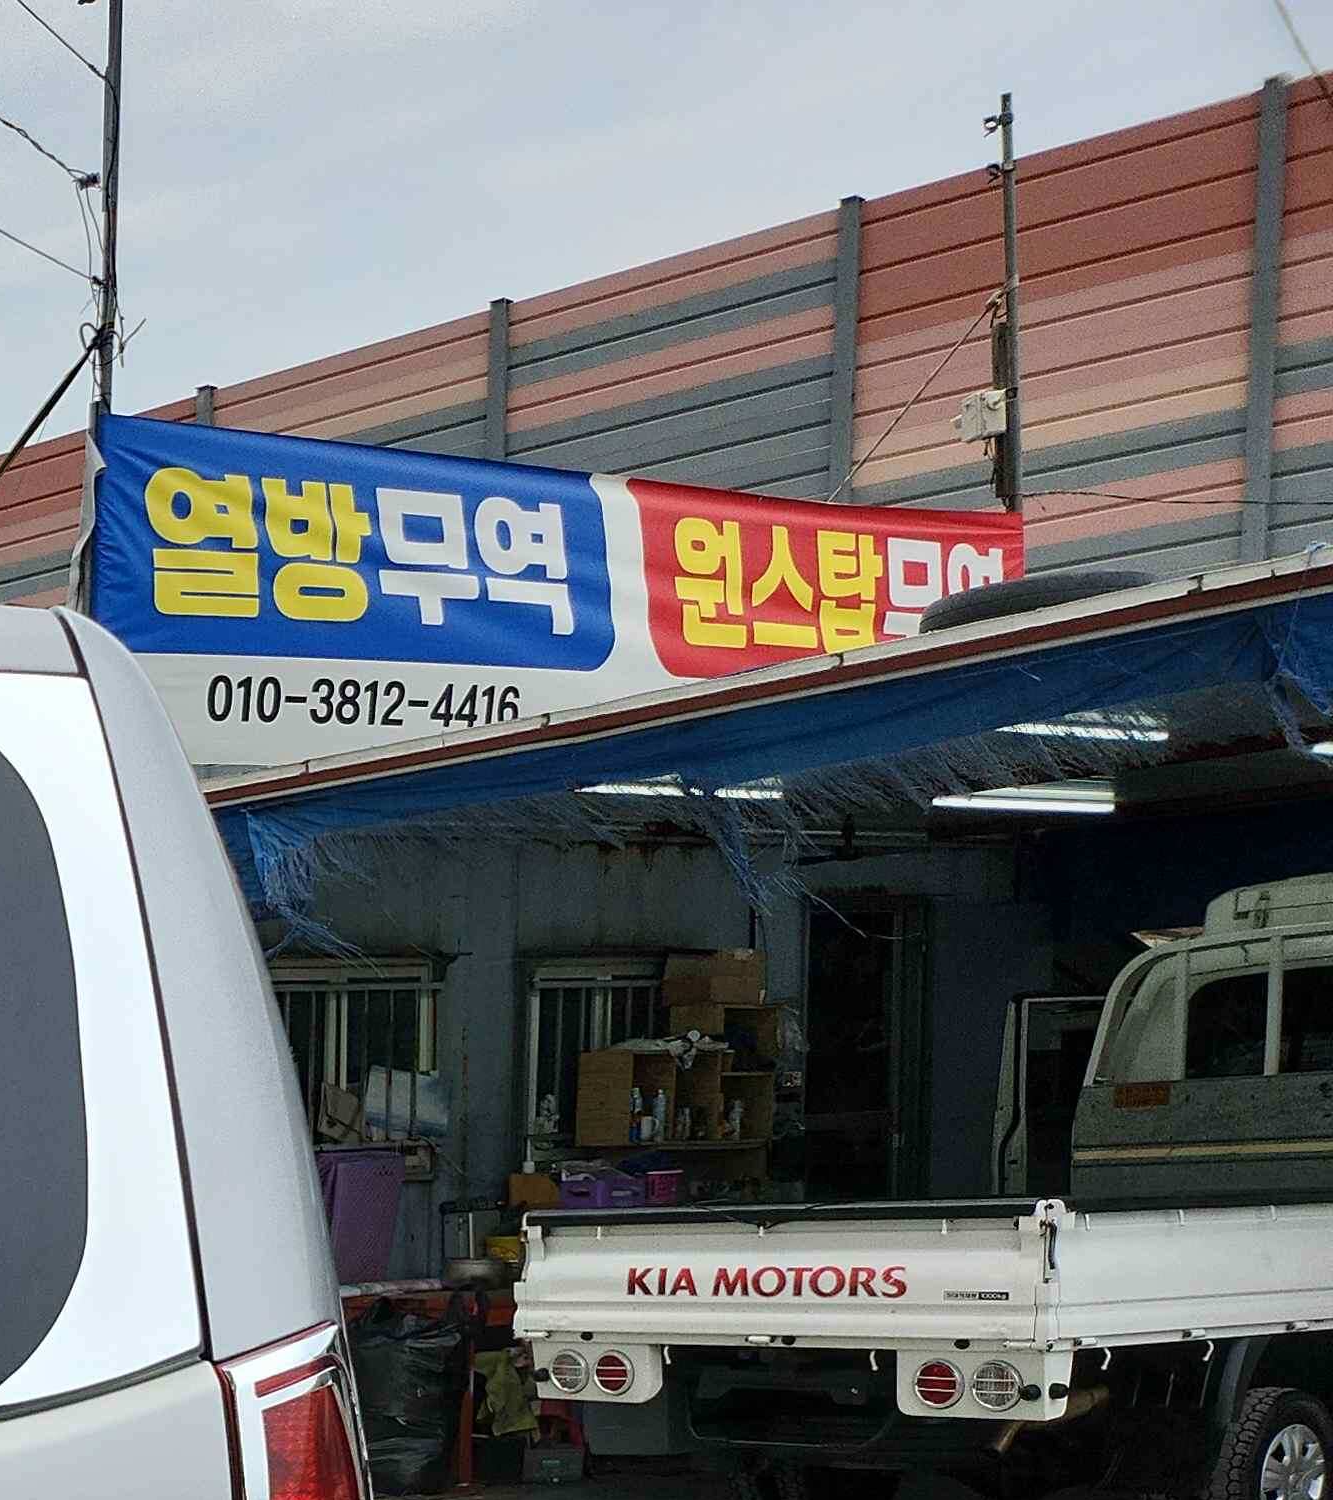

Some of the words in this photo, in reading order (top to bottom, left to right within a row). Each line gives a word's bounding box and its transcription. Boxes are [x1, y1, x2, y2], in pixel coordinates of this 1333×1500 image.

[144, 466, 574, 636] 열방무역
[207, 674, 520, 728] 010-3812-4416
[627, 1266, 699, 1298] KIA
[711, 1265, 909, 1299] MOTORS
